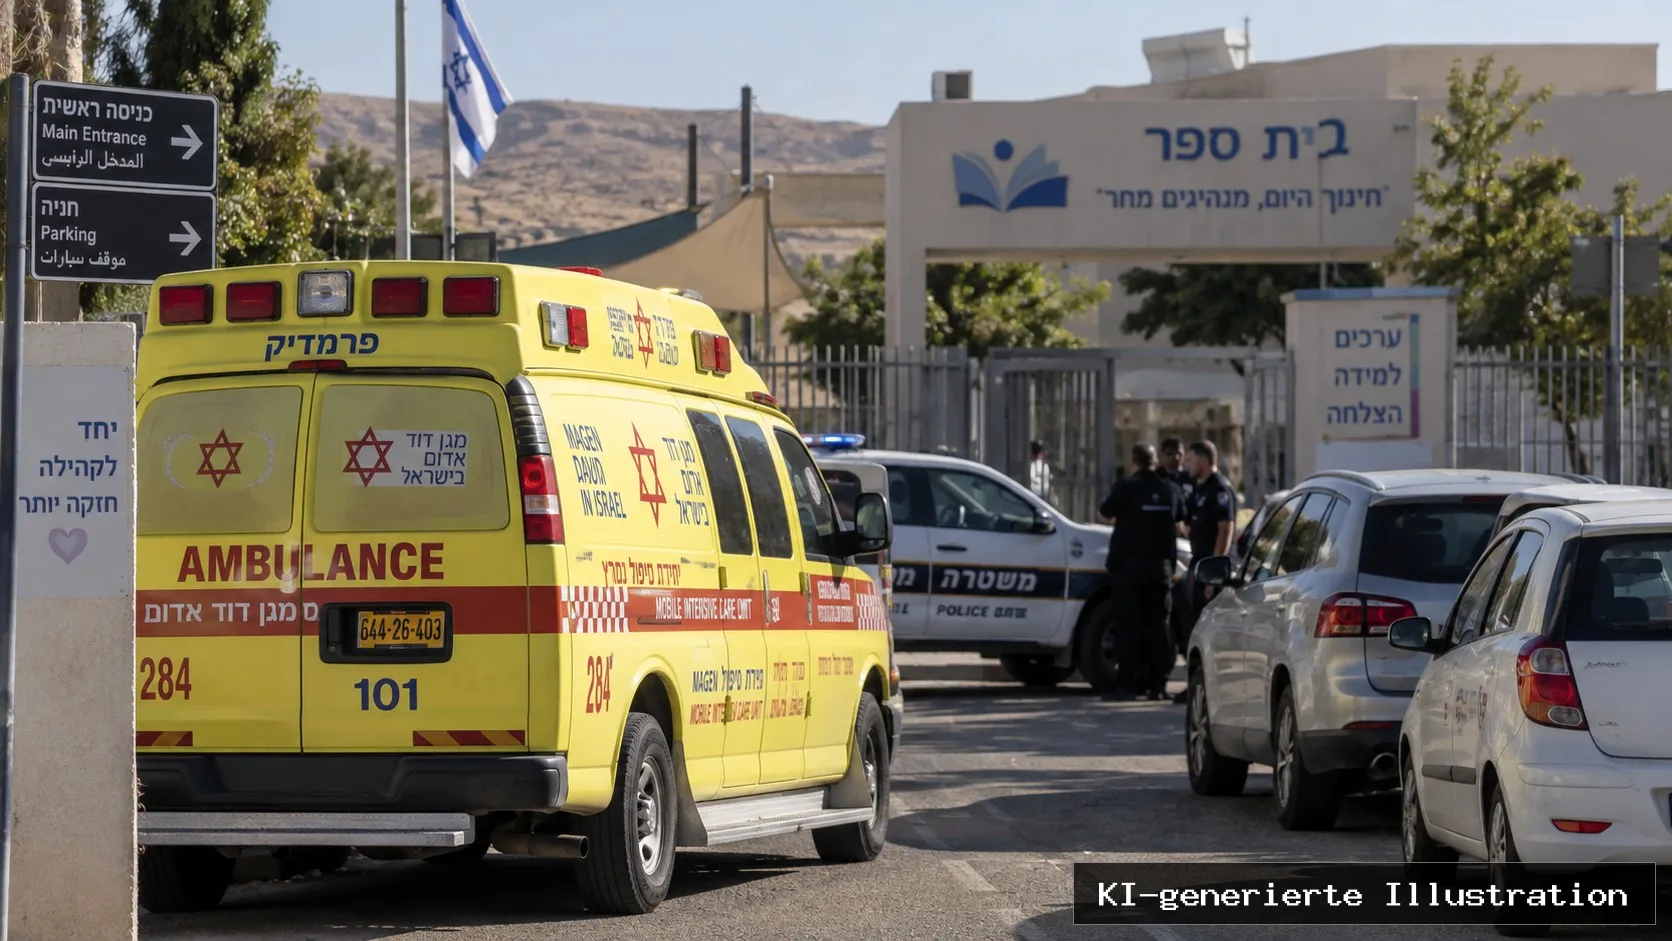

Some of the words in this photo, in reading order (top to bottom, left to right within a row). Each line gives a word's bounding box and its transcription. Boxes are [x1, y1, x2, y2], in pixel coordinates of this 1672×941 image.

[43, 97, 100, 117] ראשית
[106, 103, 153, 122] כניסה
[42, 123, 78, 140] Main
[83, 126, 147, 146] Entrance
[1144, 127, 1242, 161] ספר
[1262, 117, 1350, 161] בית
[97, 150, 144, 170] المدخل
[41, 199, 79, 217] חניה
[1162, 188, 1250, 209] מנהיגים
[1257, 188, 1312, 212] היום,
[41, 225, 97, 246] Parking
[264, 332, 379, 361] פרמדיק
[1335, 329, 1402, 349] ערכים
[1334, 362, 1402, 386] למידה
[1327, 401, 1402, 424] הצלחה
[78, 421, 118, 439] יחד
[406, 433, 434, 448] דוד
[563, 423, 603, 452] MAGEN
[440, 434, 467, 451] מגן
[39, 455, 118, 481] לקהילה
[424, 451, 466, 467] אדום
[401, 466, 465, 485] בישראל
[19, 496, 60, 513] יותר
[66, 496, 118, 518] חזקה
[580, 489, 594, 516] IN
[593, 491, 627, 519] ISRAEL
[177, 542, 444, 583] AMBULANCE
[940, 568, 1038, 591] משטרה
[144, 603, 202, 623] אדום
[212, 602, 250, 622] דוד
[259, 602, 297, 627] מגן
[937, 604, 989, 617] POLICE
[139, 657, 192, 701] 284
[586, 655, 611, 714] 284
[354, 678, 418, 711] 101
